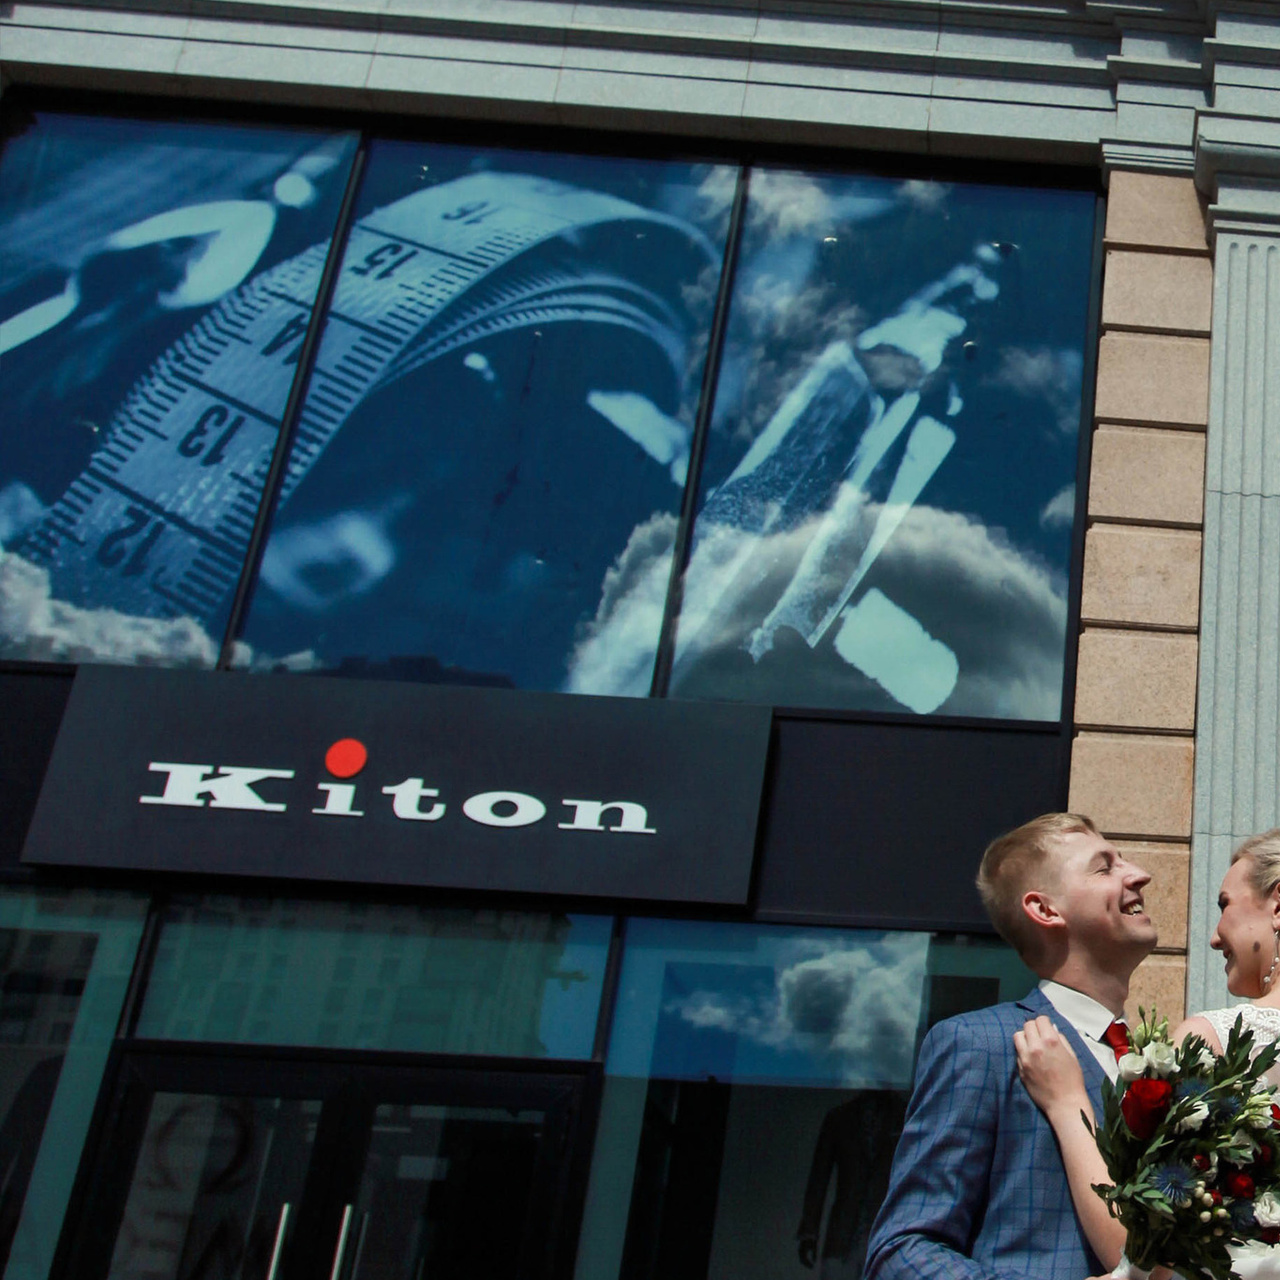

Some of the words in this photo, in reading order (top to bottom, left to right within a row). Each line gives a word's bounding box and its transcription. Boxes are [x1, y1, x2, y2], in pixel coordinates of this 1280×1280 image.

[350, 242, 419, 281] 15
[176, 404, 246, 467] 13
[97, 504, 167, 577] 12
[138, 737, 658, 835] Kiton
